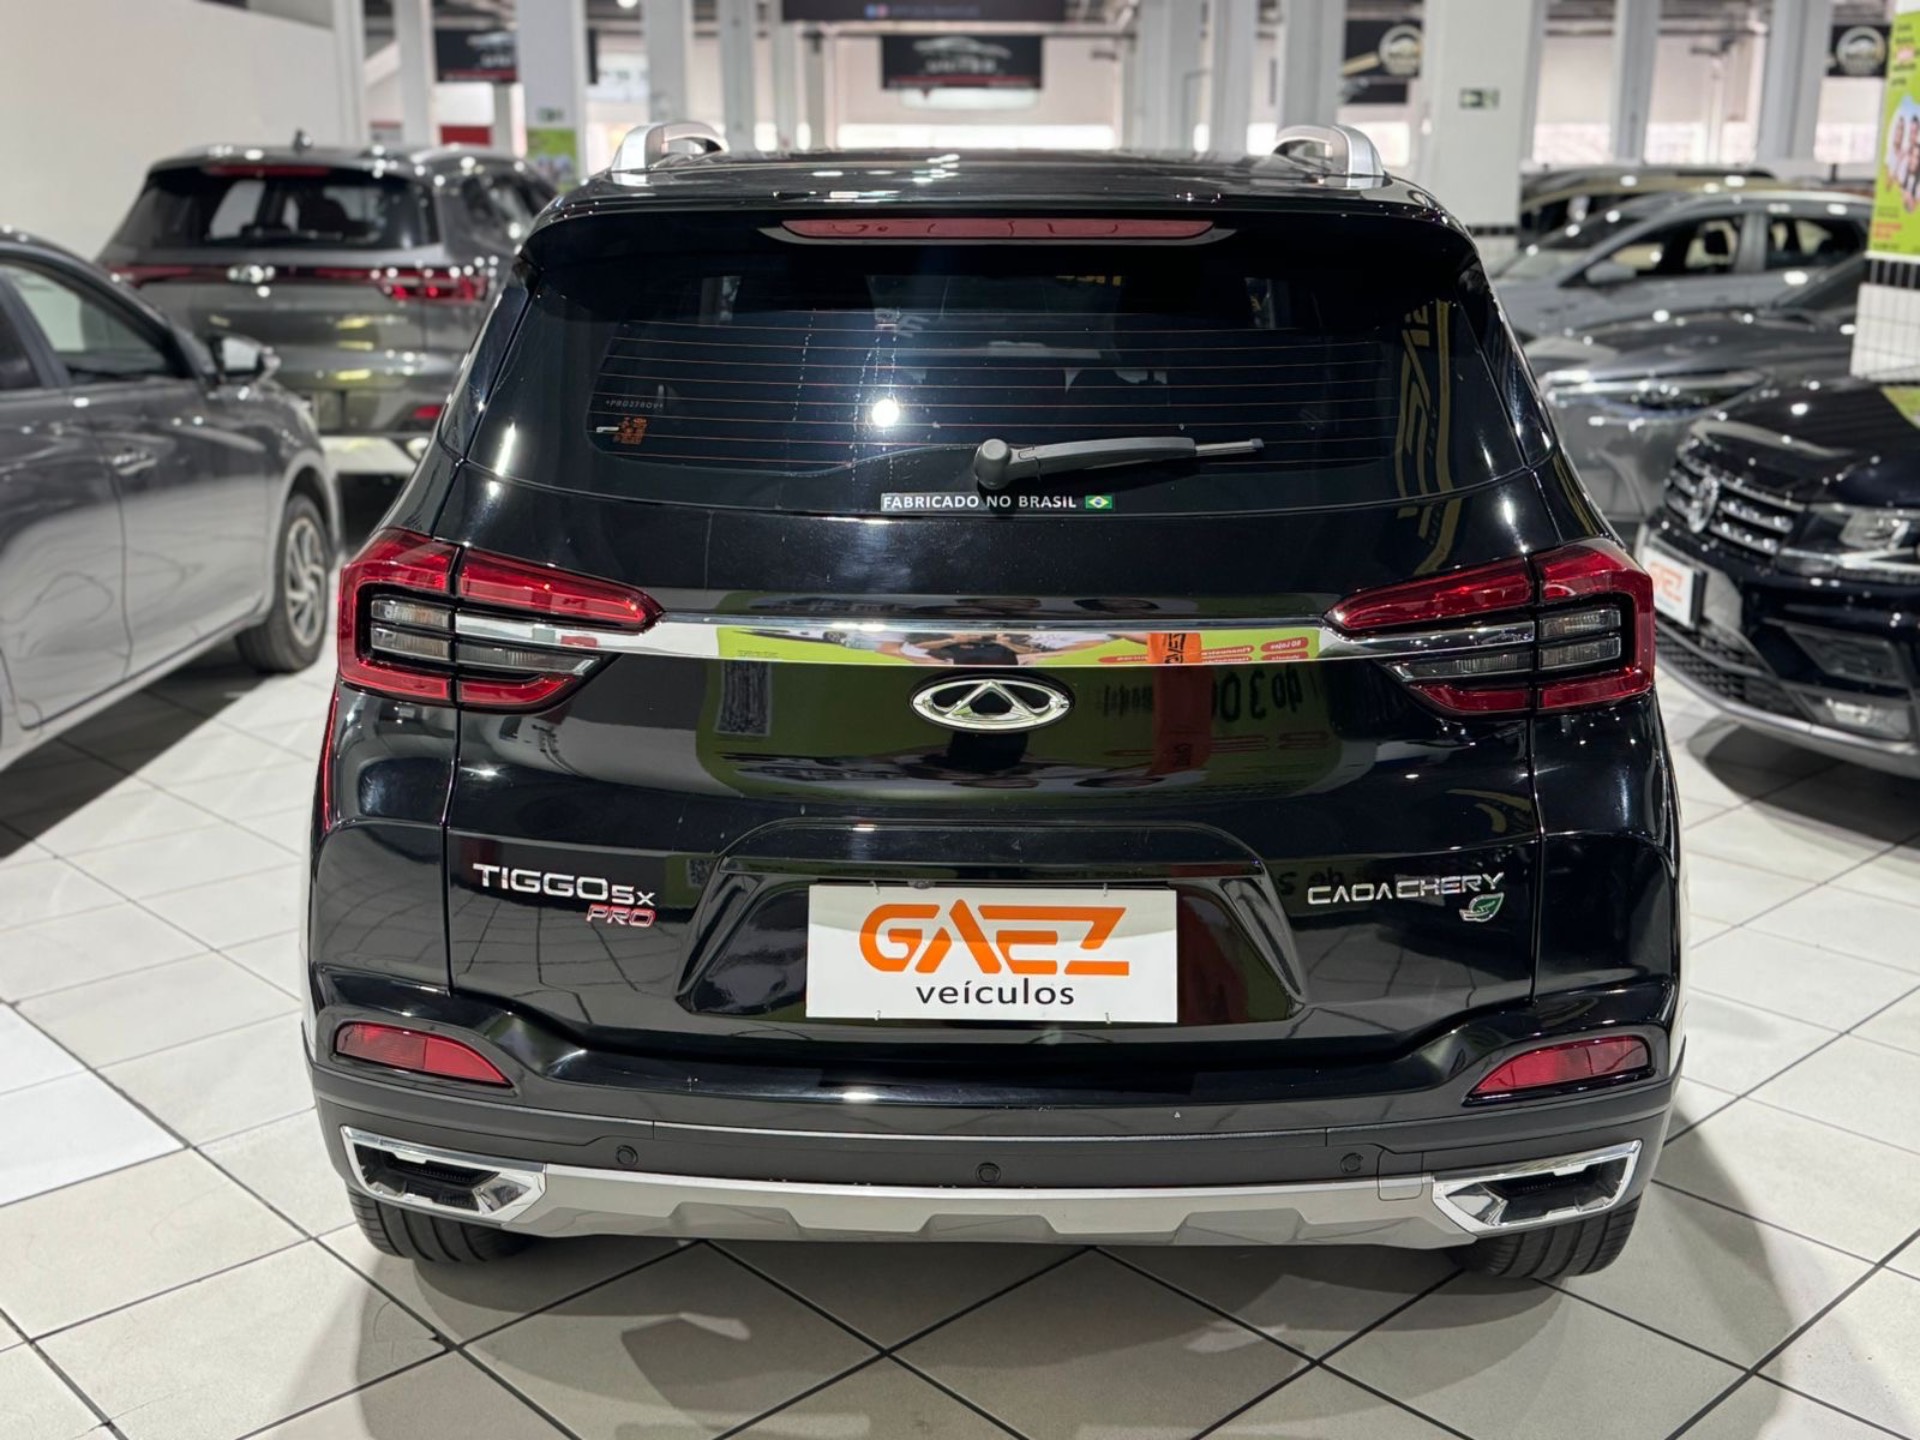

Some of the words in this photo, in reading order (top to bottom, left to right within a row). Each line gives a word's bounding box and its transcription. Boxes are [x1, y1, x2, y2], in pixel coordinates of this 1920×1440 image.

[883, 495, 979, 509] FABRICADO
[986, 495, 1011, 508] NO
[1018, 495, 1077, 508] BRASIL
[585, 903, 657, 928] PRO
[858, 898, 1130, 977] GAEZ
[915, 977, 1075, 1005] veículos
